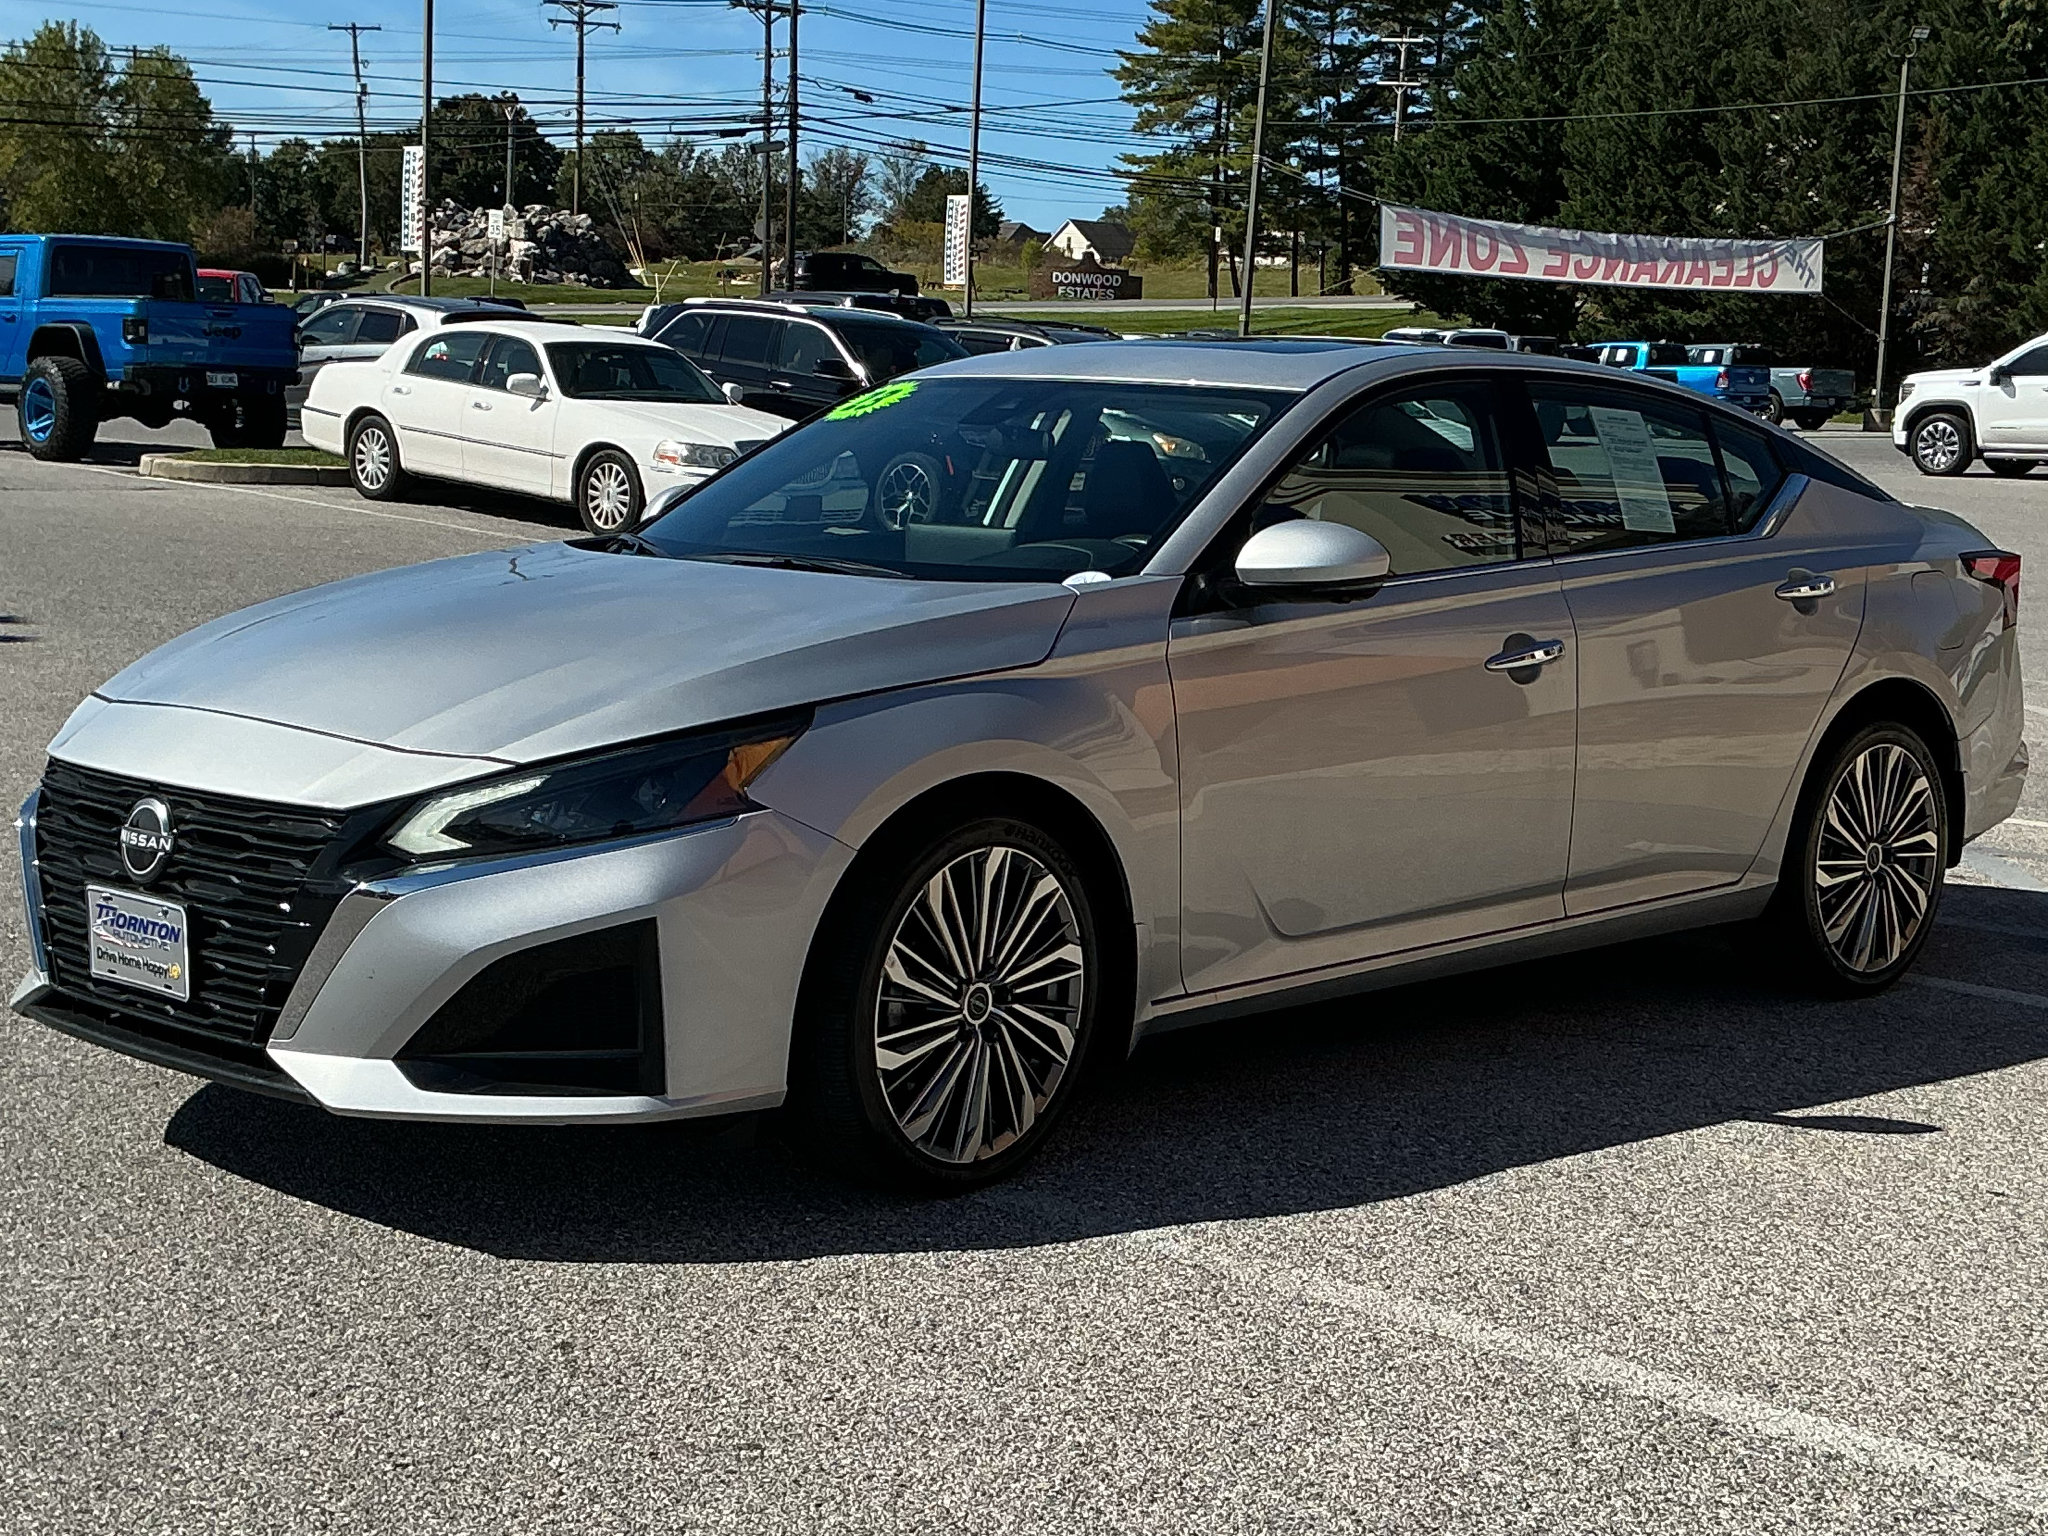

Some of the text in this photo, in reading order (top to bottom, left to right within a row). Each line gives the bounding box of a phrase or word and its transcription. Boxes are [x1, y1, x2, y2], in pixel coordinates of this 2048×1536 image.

[489, 225, 501, 236] 35
[1052, 271, 1121, 287] DONWOOD
[1058, 286, 1115, 300] ESTATES
[202, 321, 241, 339] Jeep
[121, 829, 171, 851] NISSAN
[96, 903, 181, 943] THORNTON
[97, 946, 117, 963] Drive
[119, 951, 142, 969] Home
